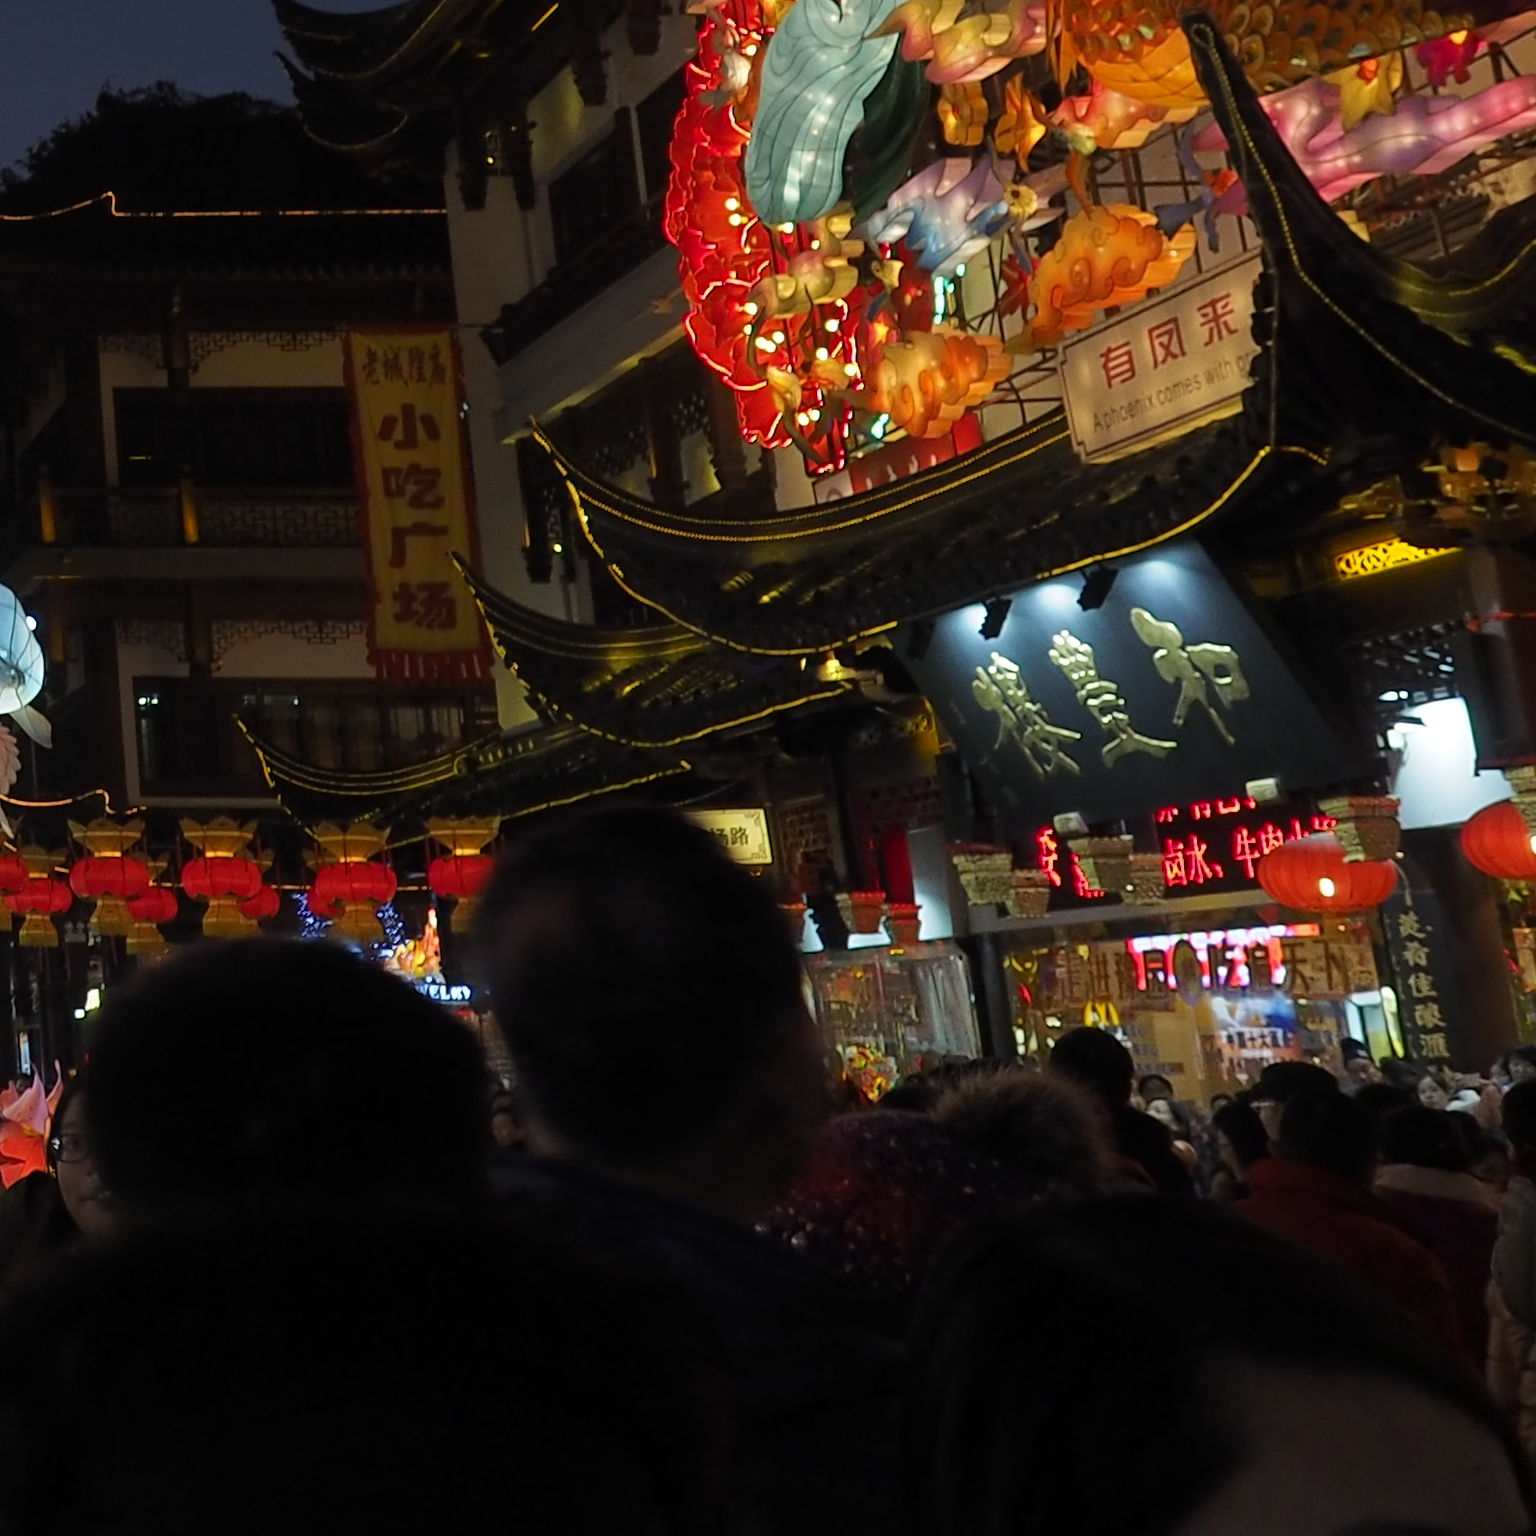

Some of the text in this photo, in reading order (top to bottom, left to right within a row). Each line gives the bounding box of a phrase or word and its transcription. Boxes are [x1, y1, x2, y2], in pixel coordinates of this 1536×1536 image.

[1100, 292, 1240, 390] 有凤来
[1156, 375, 1202, 405] comes
[1205, 357, 1233, 385] with
[378, 402, 458, 631] 小吃广场
